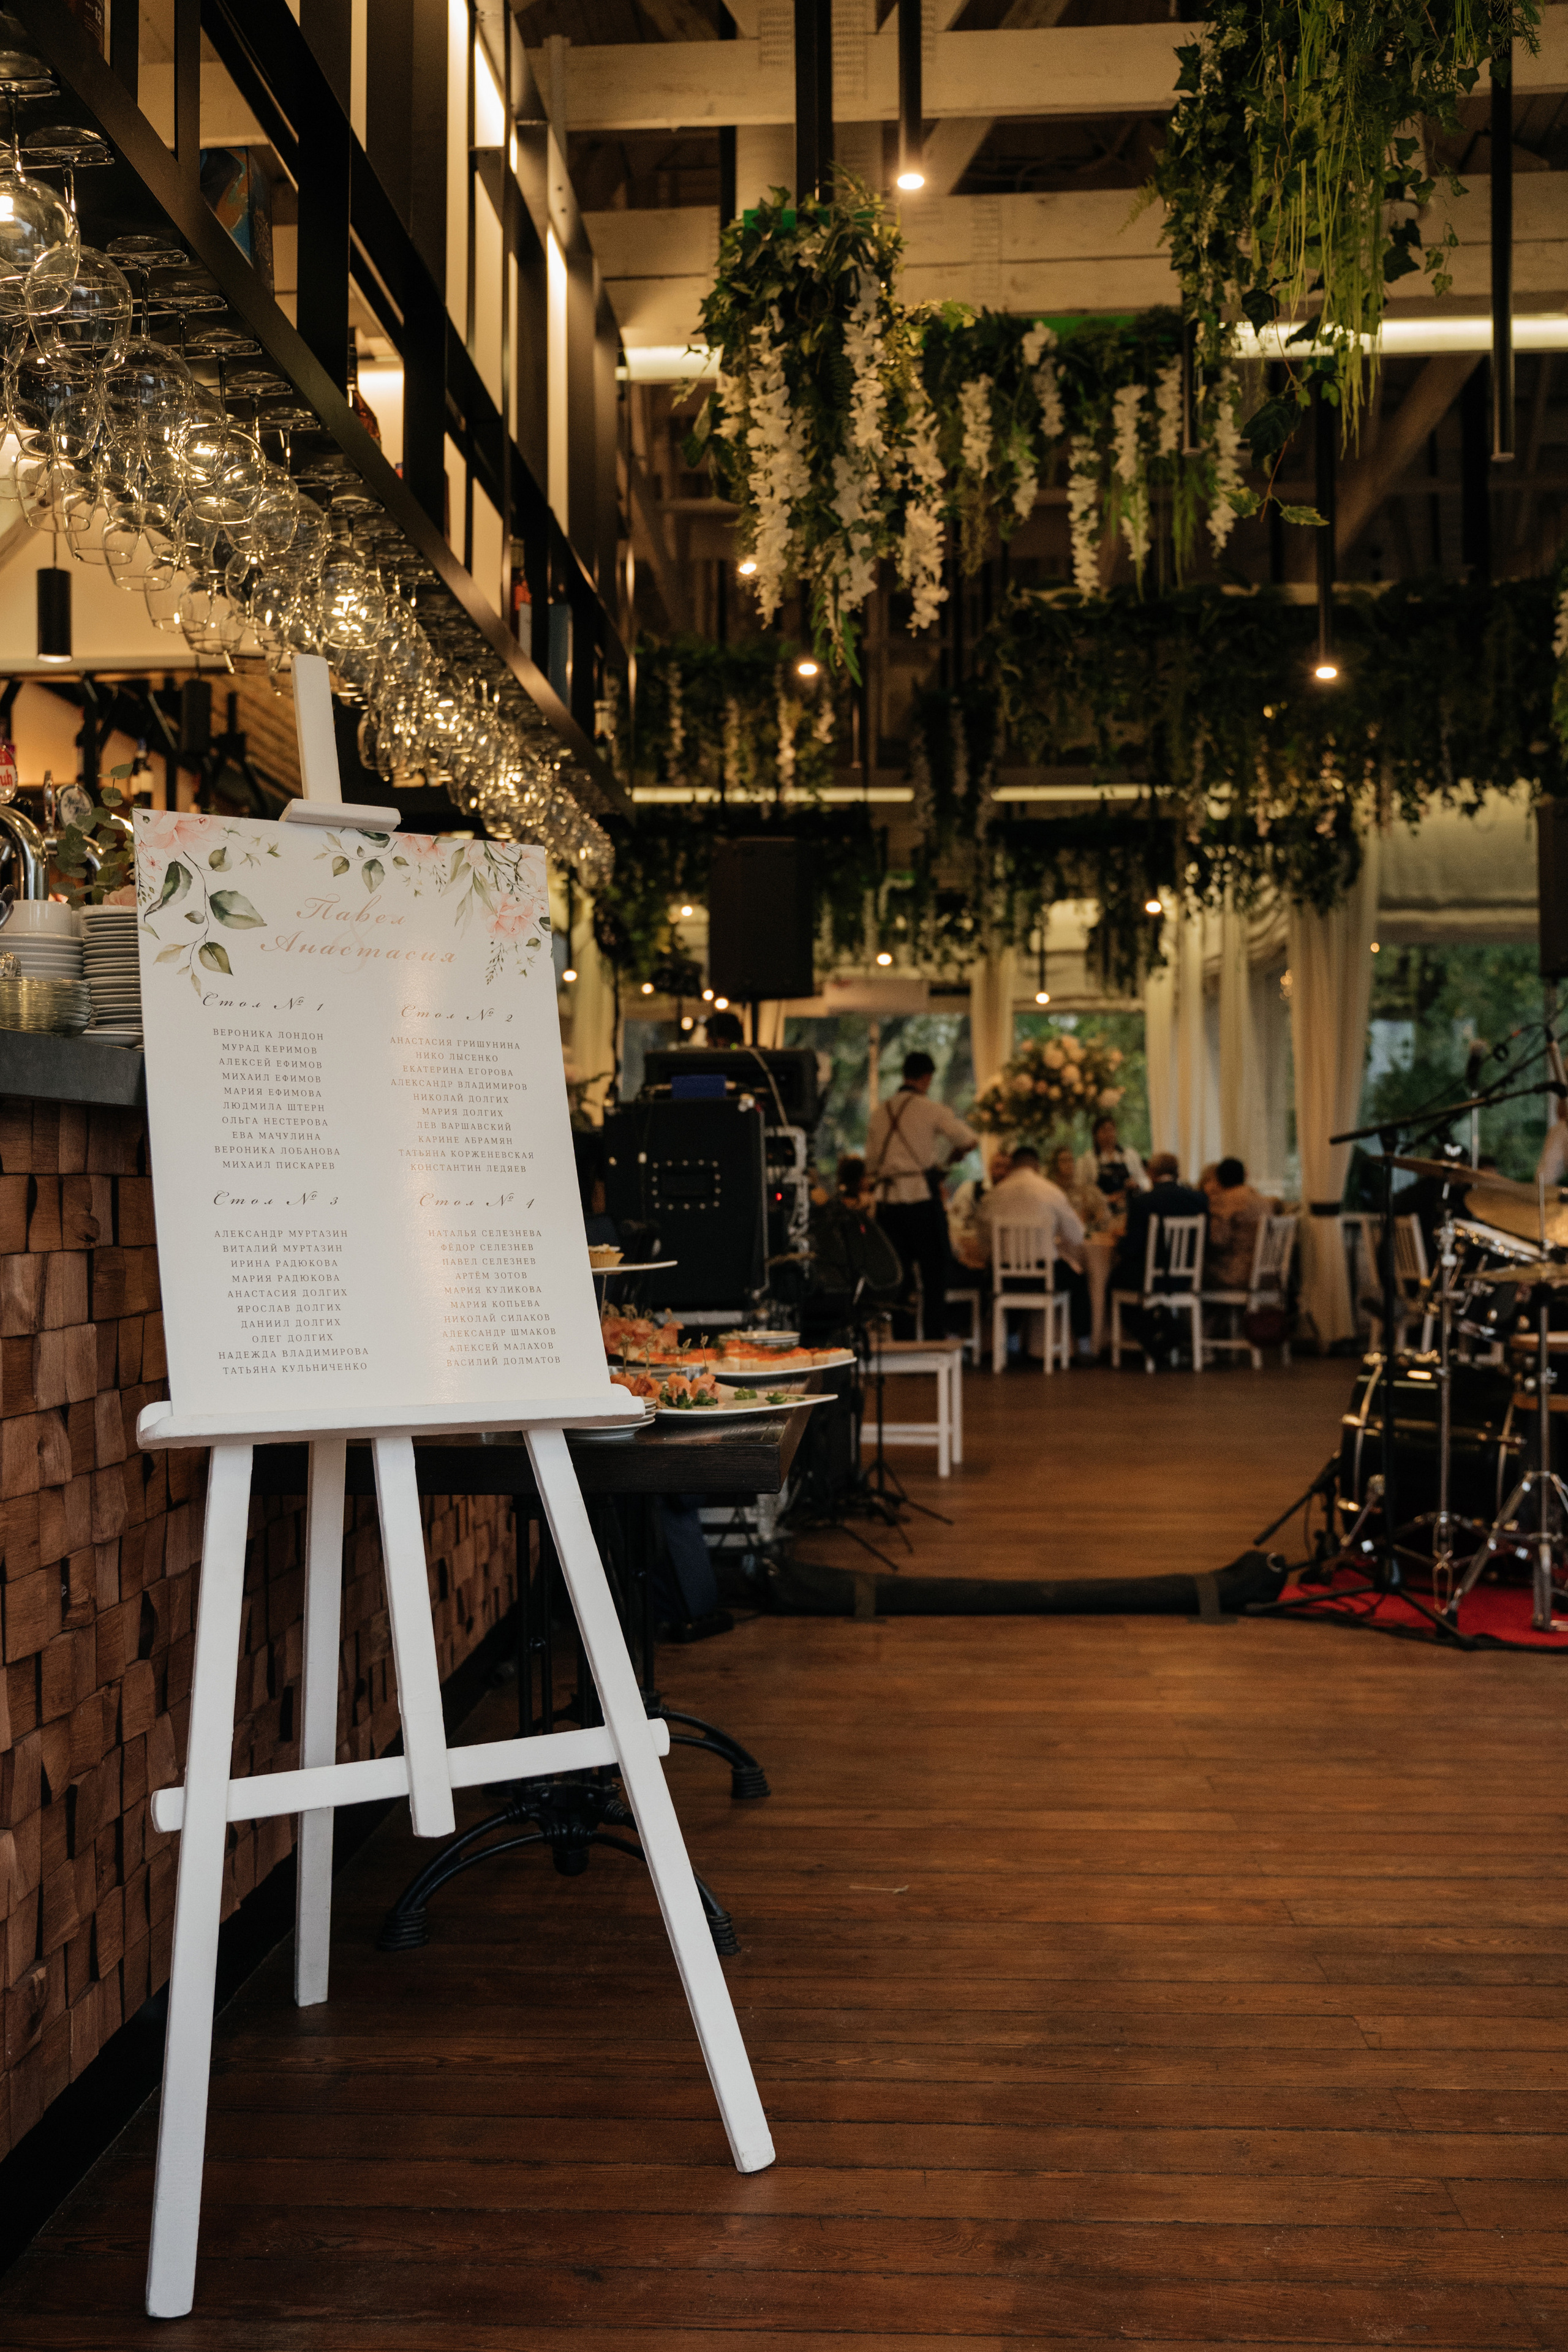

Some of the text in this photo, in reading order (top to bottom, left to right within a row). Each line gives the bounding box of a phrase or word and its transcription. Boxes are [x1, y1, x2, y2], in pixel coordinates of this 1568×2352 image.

[296, 893, 405, 924] Павел
[260, 930, 456, 962] Анастасия
[202, 992, 261, 1008] Стол
[401, 1005, 455, 1019] Стол
[505, 1014, 513, 1023] 2
[213, 1028, 323, 1041] ВЕРОНИКА ЛОНДОН
[390, 1036, 521, 1050] АНАСТАСИЯ ГРИШУНИНА
[222, 1043, 317, 1055] МУРАД КЕРИМОВ
[219, 1057, 322, 1069] АЛЕКСЕЙ ЕФИМОВ
[415, 1052, 499, 1063] НИКО ЛЫСЕНКО
[402, 1065, 513, 1077] ЕКАТЕРИНА ЕГОРОВА
[222, 1072, 322, 1084] МИХАИЛ ЕФИМОВ
[390, 1078, 527, 1091] АЛЕКСАНДР ВЛАДИМИРОВ
[224, 1087, 322, 1098] МАРИЯ ЕФИМОВА
[413, 1093, 509, 1104] НИКОЛАЙ ДОЛГИХ
[223, 1101, 325, 1112] ЛЮДМИЛА ШТЕРН
[421, 1107, 503, 1117] МАРИЯ ДОЛГИХ
[221, 1116, 328, 1126] ОЛЬГА НЕСТЕРОВА
[417, 1121, 511, 1131] ЛЕВ ВАРШАВСКИЙ
[232, 1131, 321, 1140] ЕВА МАЧУЛИНА
[418, 1135, 513, 1145] КАРИНЕ АБРАМЯН
[214, 1145, 341, 1156] ВЕРОНИКА ЛОБАНОВА
[398, 1149, 534, 1159] ТАТЬЯНА КОРЖЕНЕВСКАЯ
[222, 1160, 335, 1170] МИХАИЛ ПИСКАРЕВ
[410, 1164, 527, 1174] КОНСТАНТИН ЛЕДЯЕВ
[213, 1190, 273, 1205] Стол
[330, 1196, 339, 1205] 3
[419, 1193, 475, 1207] Стол
[214, 1229, 348, 1238] АЛЕКСАНДР МУРТАЗИН
[222, 1243, 342, 1253] ВИТАЛИЙ МУРТАЗИН
[440, 1242, 475, 1252] ФЁДОР
[230, 1259, 338, 1268] ИРИНА РАДЮКОВА
[232, 1274, 340, 1283] МАРИЯ РАДЮКОВА
[455, 1270, 490, 1280] АРТЁМ
[227, 1288, 348, 1298] АНАСТАСИЯ ДОЛГИХ
[485, 1285, 542, 1294] КУЛИКОВА
[237, 1303, 341, 1313] ЯРОСЛАВ ДОЛГИХ
[450, 1300, 540, 1309] МАРИЯ КОПЬЕВА
[241, 1318, 341, 1329] ДАНИИЛ ДОЛГИХ
[444, 1313, 550, 1323] НИКОЛАЙ СИЛАКОВ
[252, 1333, 333, 1343] ОЛЕГ ДОЛГИХ
[442, 1327, 556, 1338] АЛЕКСАНДР ШМАКОВ
[449, 1341, 554, 1352] АЛЕКСЕЙ МАЛАХОВ
[218, 1348, 369, 1360] НАДЕЖДА ВЛАДИМИРОВА
[447, 1355, 561, 1367] ВАСИЛИЙ ДОЛМАТОВ
[222, 1362, 368, 1375] ТАТЬЯНА КУЛЬНИЧЕНКО
